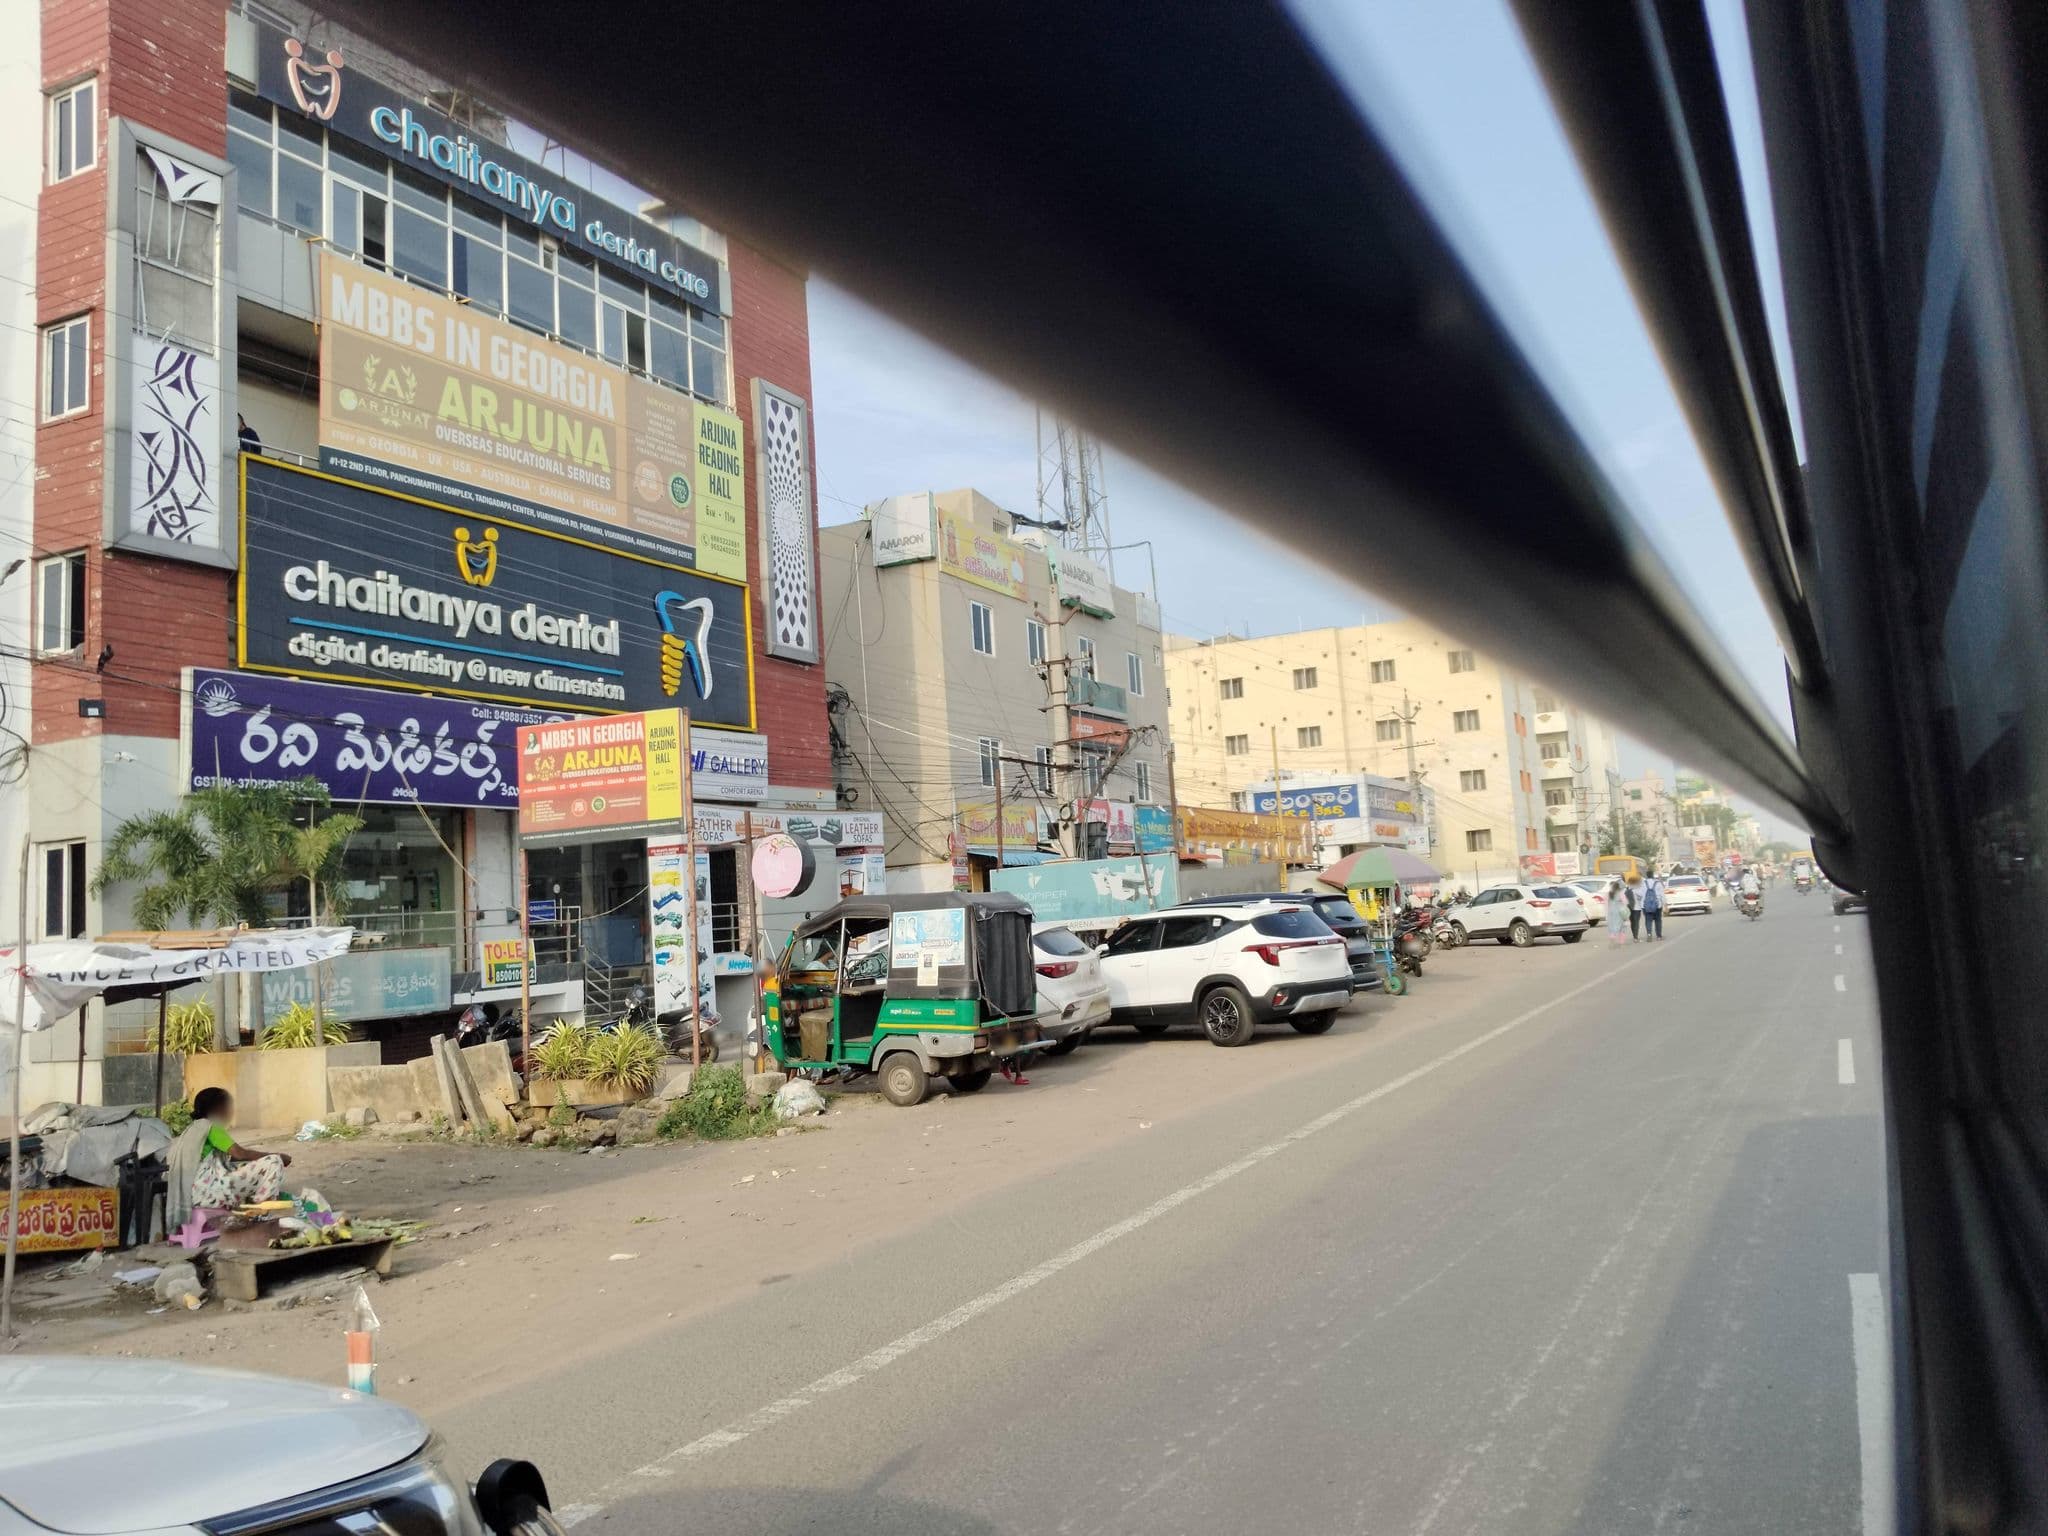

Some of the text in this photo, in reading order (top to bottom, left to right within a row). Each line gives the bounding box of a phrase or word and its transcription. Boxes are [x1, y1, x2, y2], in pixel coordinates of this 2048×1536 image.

[370, 104, 709, 299] chaitanya dental care
[331, 273, 615, 420] MBBS IN GEORGIA
[438, 375, 611, 473] ARJUNA
[701, 418, 737, 450] ARJUNA
[348, 460, 364, 472] 2ND
[436, 424, 492, 454] OVERSEAS
[495, 442, 565, 476] EDUCATIONAL
[567, 465, 611, 491] SERVICES
[699, 443, 740, 476] READING
[368, 435, 418, 460] GEORGIA
[428, 452, 442, 467] UK
[453, 457, 472, 474] USA
[480, 468, 531, 489] AUSTRALIA
[538, 484, 575, 505] CANADA
[582, 497, 617, 516] IRELAND
[709, 473, 732, 499] HALL
[880, 534, 923, 550] AMARON
[283, 560, 621, 656] chaitanya dental
[288, 632, 625, 702] digital dentistry @ new dimension
[472, 707, 492, 719] Cell:
[240, 703, 318, 768] రవి
[541, 721, 644, 750] MBBS IN GEORGIA
[650, 726, 675, 739] ARJUNA
[648, 738, 676, 752] READING
[562, 744, 643, 771] ARJUNA
[655, 752, 670, 764] HALL
[710, 755, 766, 775] GALLERY
[721, 787, 764, 796] COMFORT ARENA
[693, 817, 732, 832] EATHER
[698, 810, 721, 818] ORIGINAL
[697, 831, 724, 842] SOFAS
[845, 823, 879, 834] LEATHER
[852, 834, 872, 843] SOFAS
[484, 942, 523, 960] TO-LE
[265, 974, 352, 1002] whies
